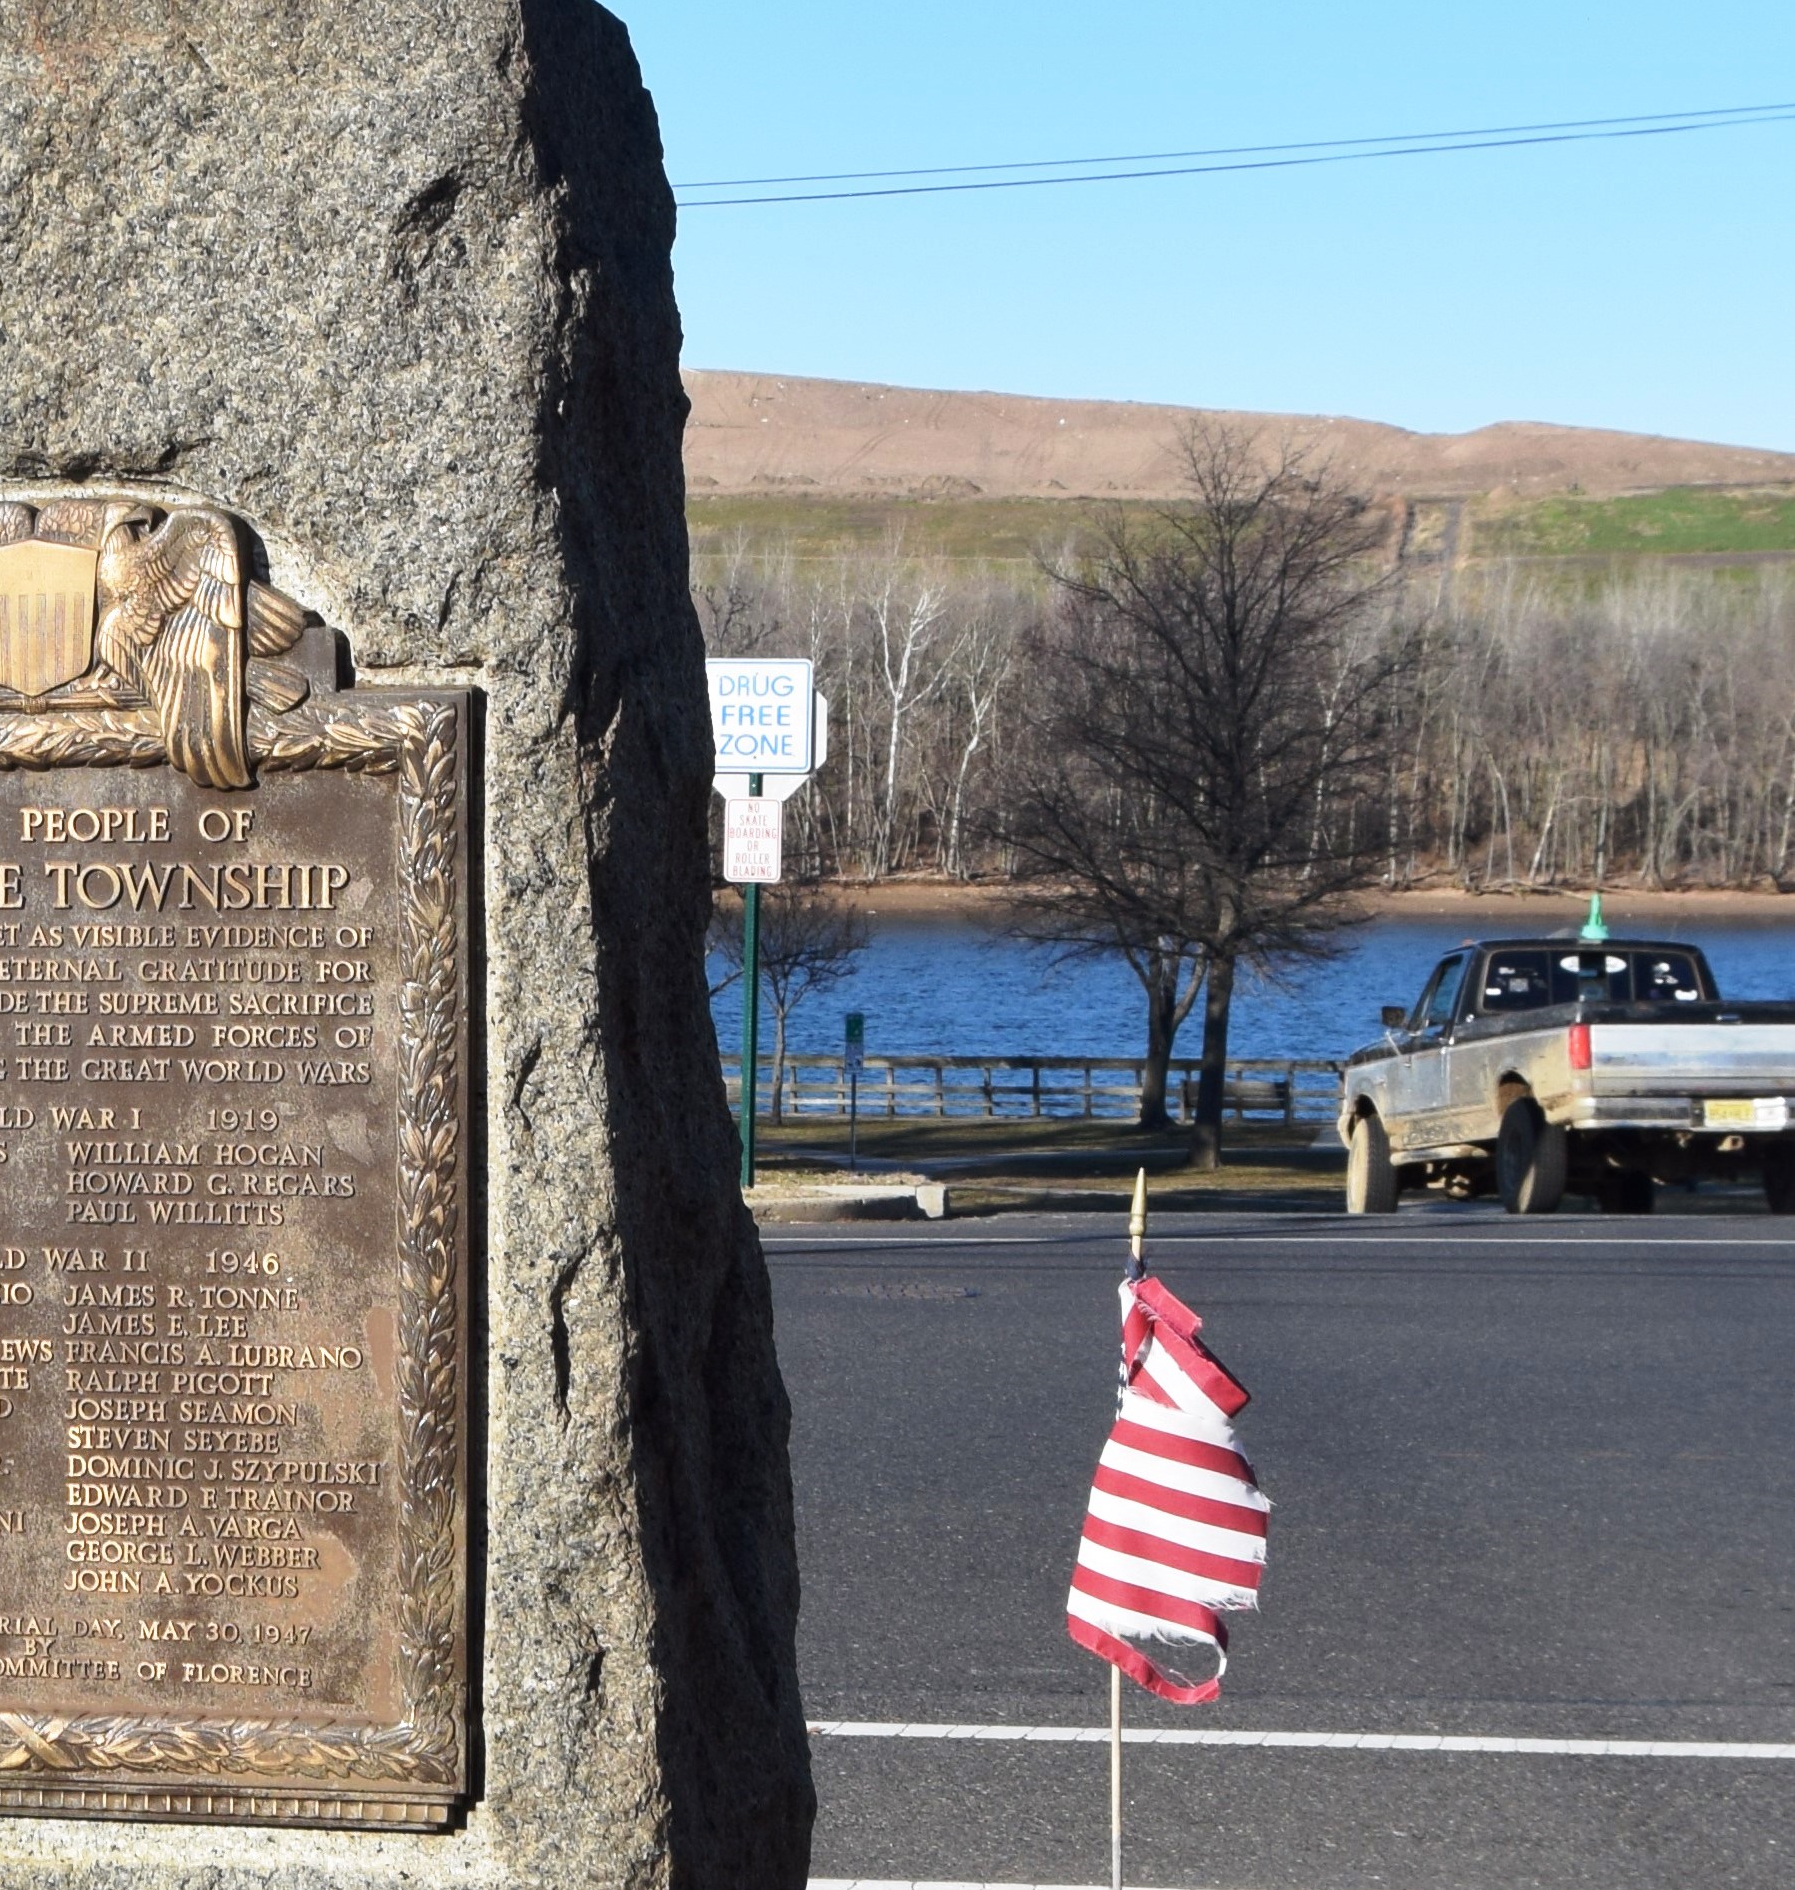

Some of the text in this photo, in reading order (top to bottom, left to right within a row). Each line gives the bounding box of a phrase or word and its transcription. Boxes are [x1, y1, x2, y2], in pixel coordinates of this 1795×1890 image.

[719, 675, 794, 696] DRUG
[722, 705, 791, 726] FREE
[719, 734, 792, 755] ZONE
[748, 803, 759, 813] NO
[20, 809, 171, 842] PEOPLE
[199, 809, 255, 842] OF
[729, 828, 778, 839] BOARDING
[747, 840, 758, 851] OR
[735, 853, 769, 864] ROLLER
[733, 866, 771, 877] BLADING
[45, 862, 350, 911] TOWNSHIP
[28, 926, 64, 947] AS
[69, 926, 175, 948] VISIBLE
[185, 927, 324, 949] EVIDENCE
[335, 927, 374, 949] OF
[138, 960, 301, 982] GRATITUDE
[316, 961, 371, 983] FOR
[36, 991, 88, 1013] THE
[99, 992, 218, 1014] SUPREME
[230, 993, 373, 1016] SACRIFICE
[15, 1023, 72, 1046] THE
[87, 1025, 195, 1047] ARMED
[211, 1026, 317, 1048] FORCES
[335, 1027, 372, 1049] OF
[17, 1058, 69, 1081] THE
[81, 1060, 171, 1082] GREAT
[178, 1061, 285, 1083] WORLD
[297, 1062, 371, 1085] WARS
[50, 1108, 118, 1130] WAR
[131, 1108, 142, 1130] I
[208, 1109, 279, 1132] 1919
[66, 1143, 323, 1166] WILLIAM HOGAN
[66, 1201, 284, 1226] PAUL WILLITTS
[42, 1248, 108, 1272] WAR
[124, 1250, 149, 1272] II
[207, 1252, 279, 1275] 1946
[64, 1286, 299, 1310] JAMES R. TONNE
[65, 1342, 362, 1369] FRANCIS A. LUBRANO
[66, 1370, 274, 1397] RALPH PIGOTT
[64, 1399, 298, 1427] JOSEPH SEAMON
[68, 1427, 279, 1454] STEVEN SEYEBE
[66, 1541, 320, 1569] GEORGE L. WEBBER
[64, 1570, 299, 1598] JOHN A. YOCKUS
[73, 1619, 125, 1640] DAY,
[138, 1620, 196, 1641] MAY
[255, 1625, 312, 1645] 1947
[25, 1637, 52, 1657] BY
[137, 1662, 167, 1681] OF
[182, 1663, 312, 1687] FLORENCE
